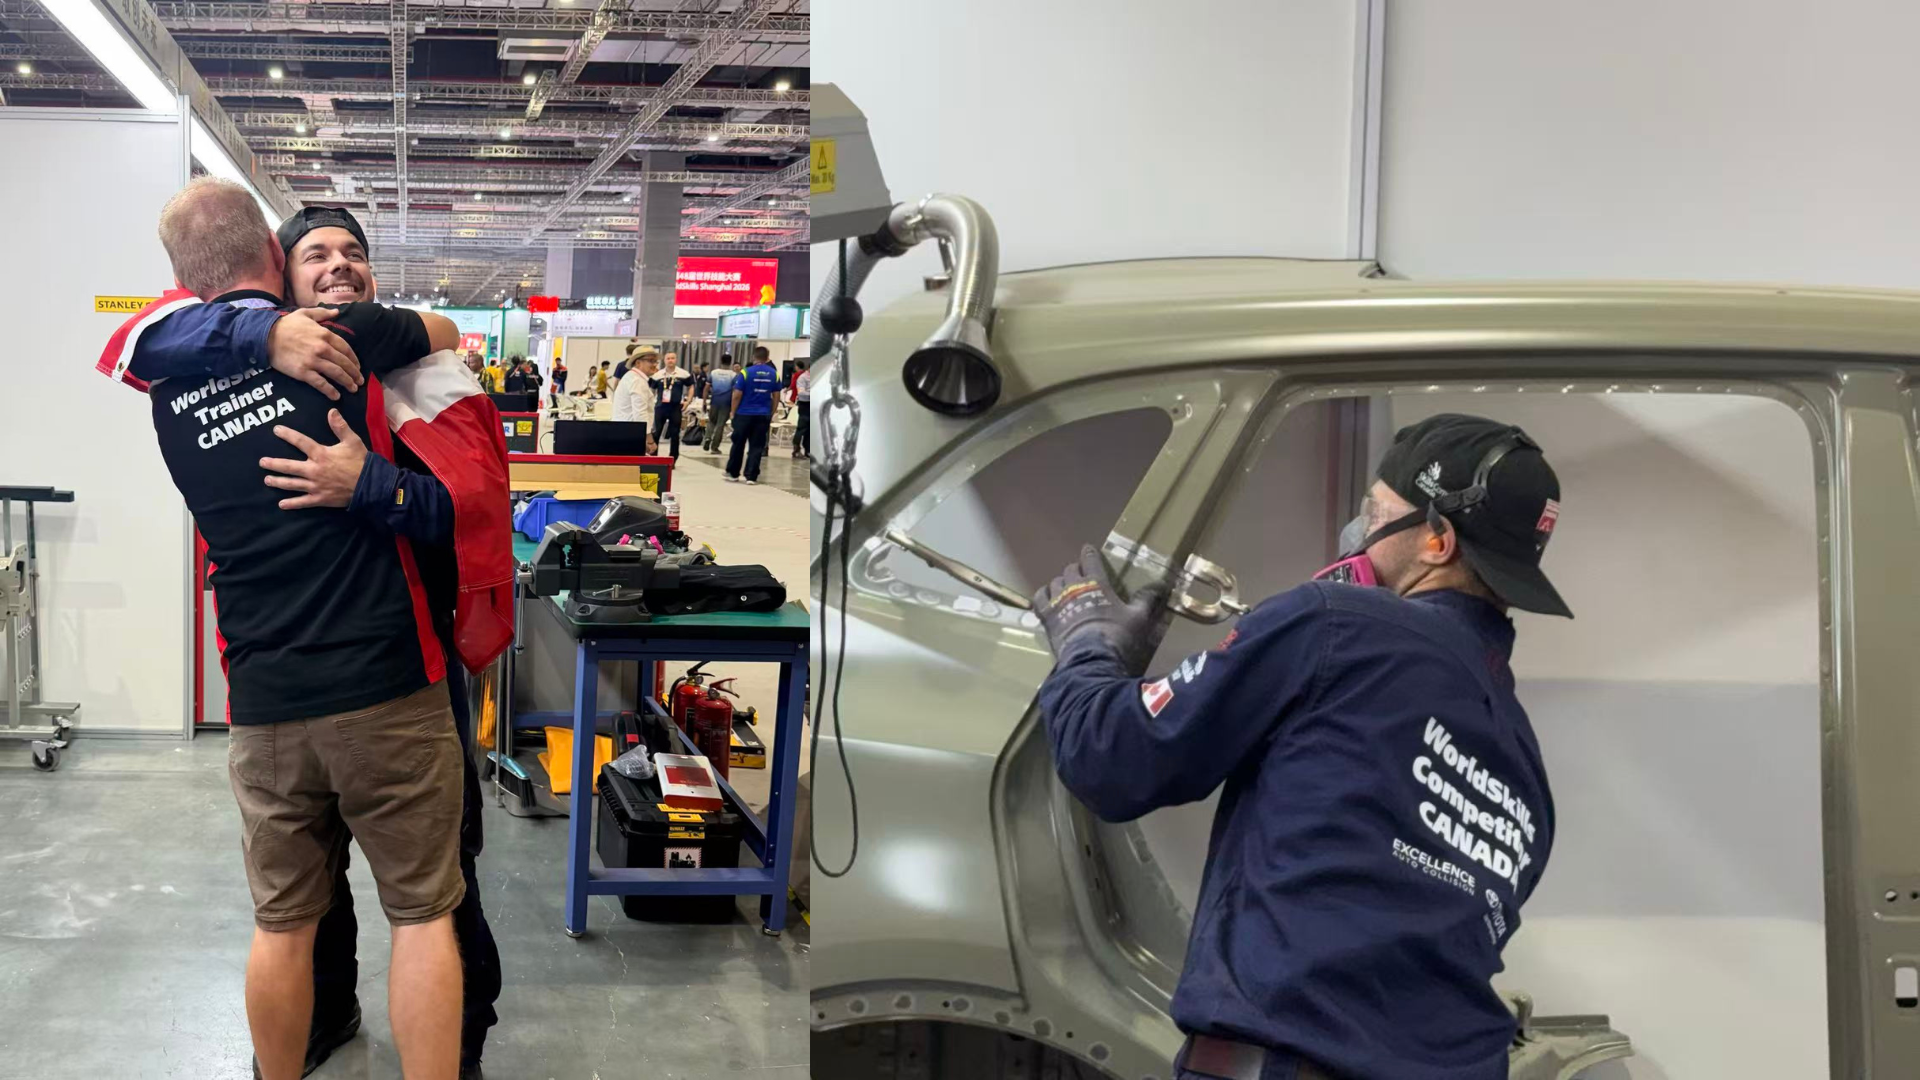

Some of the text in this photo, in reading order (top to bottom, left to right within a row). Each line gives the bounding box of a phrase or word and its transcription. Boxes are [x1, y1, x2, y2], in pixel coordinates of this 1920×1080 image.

[98, 300, 143, 309] STANLEY
[675, 282, 699, 290] ldSkills
[700, 283, 732, 292] Shanghai
[170, 366, 272, 415] WorldSk
[193, 381, 274, 426] Trainer
[197, 397, 296, 450] CANADA
[1422, 716, 1536, 843] WorldSkills
[1412, 756, 1531, 872] Competitor
[1392, 838, 1476, 888] EXCELLENCE
[1419, 801, 1519, 895] CANADA
[1392, 850, 1476, 896] AUTO COLLISION
